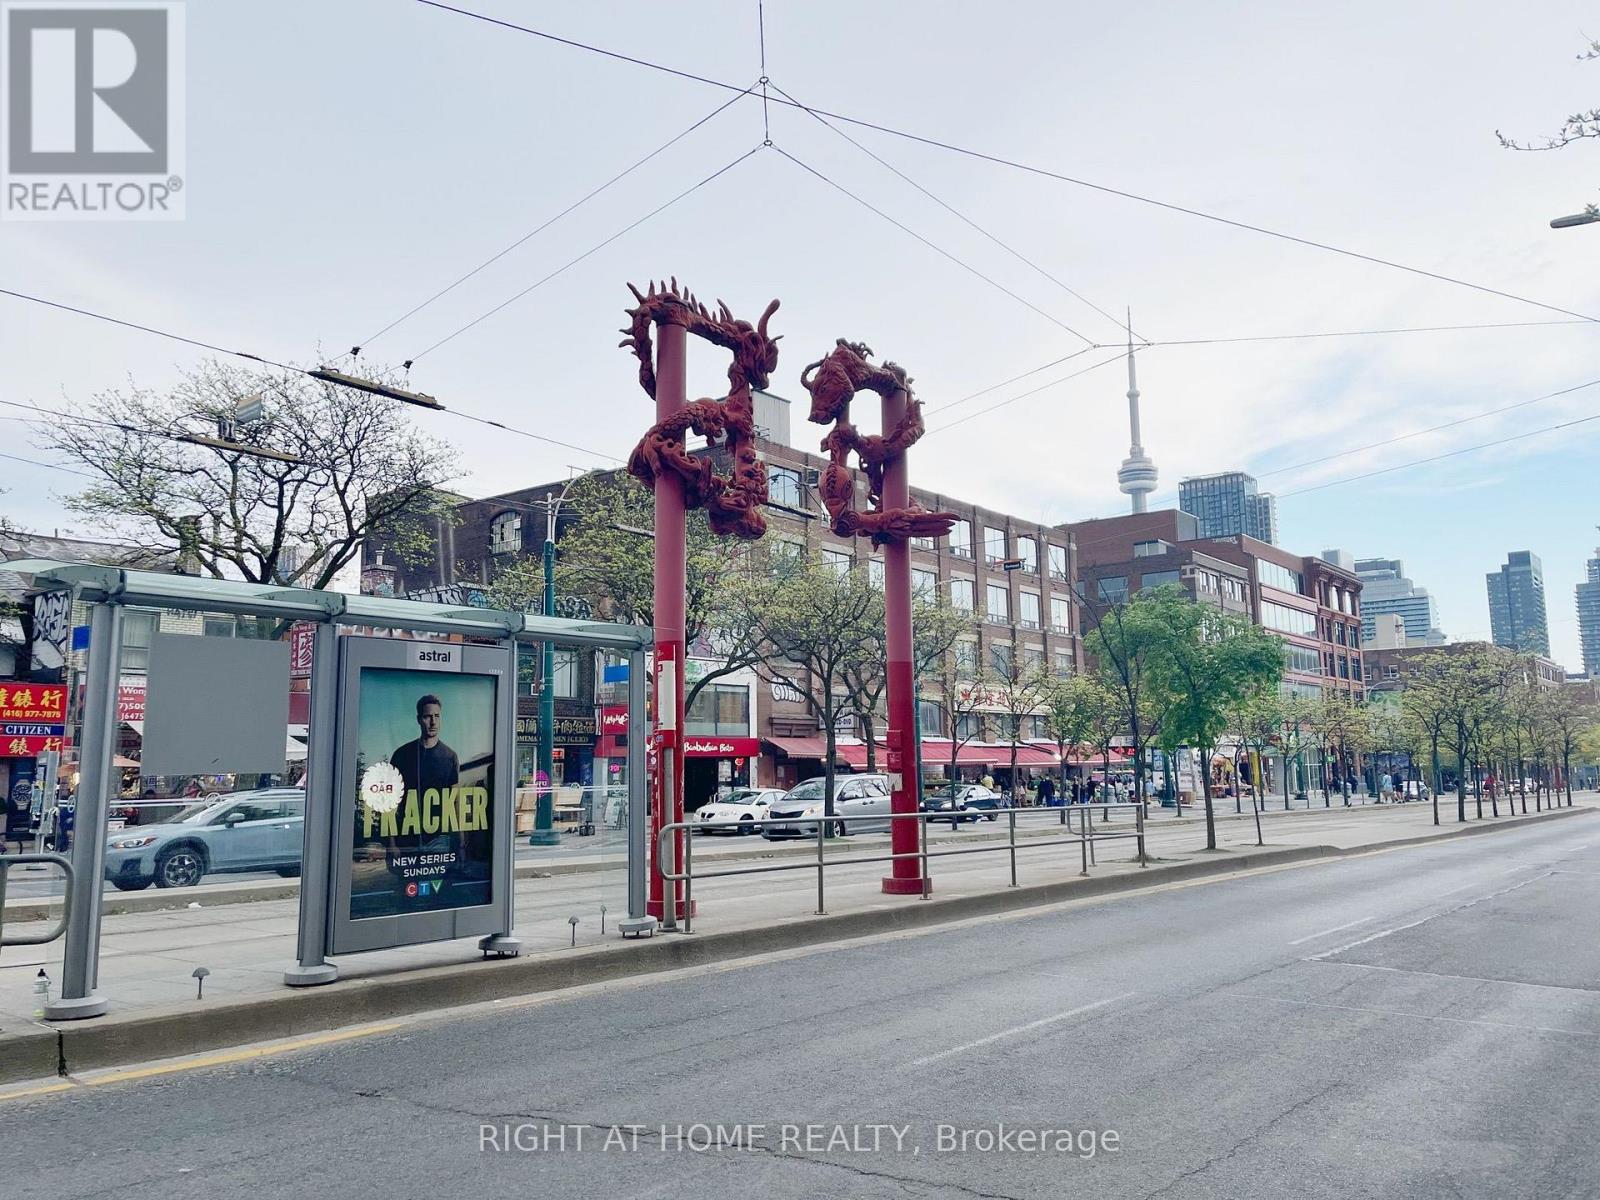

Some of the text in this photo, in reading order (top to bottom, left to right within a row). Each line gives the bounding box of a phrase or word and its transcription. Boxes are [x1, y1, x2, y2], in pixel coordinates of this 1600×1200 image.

[419, 650, 451, 662] astral
[2, 709, 23, 718] (416)
[5, 725, 51, 735] CITIZEN
[392, 853, 456, 867] NEW SERIES
[403, 866, 446, 877] SUNDAYS
[406, 880, 443, 897] CTV
